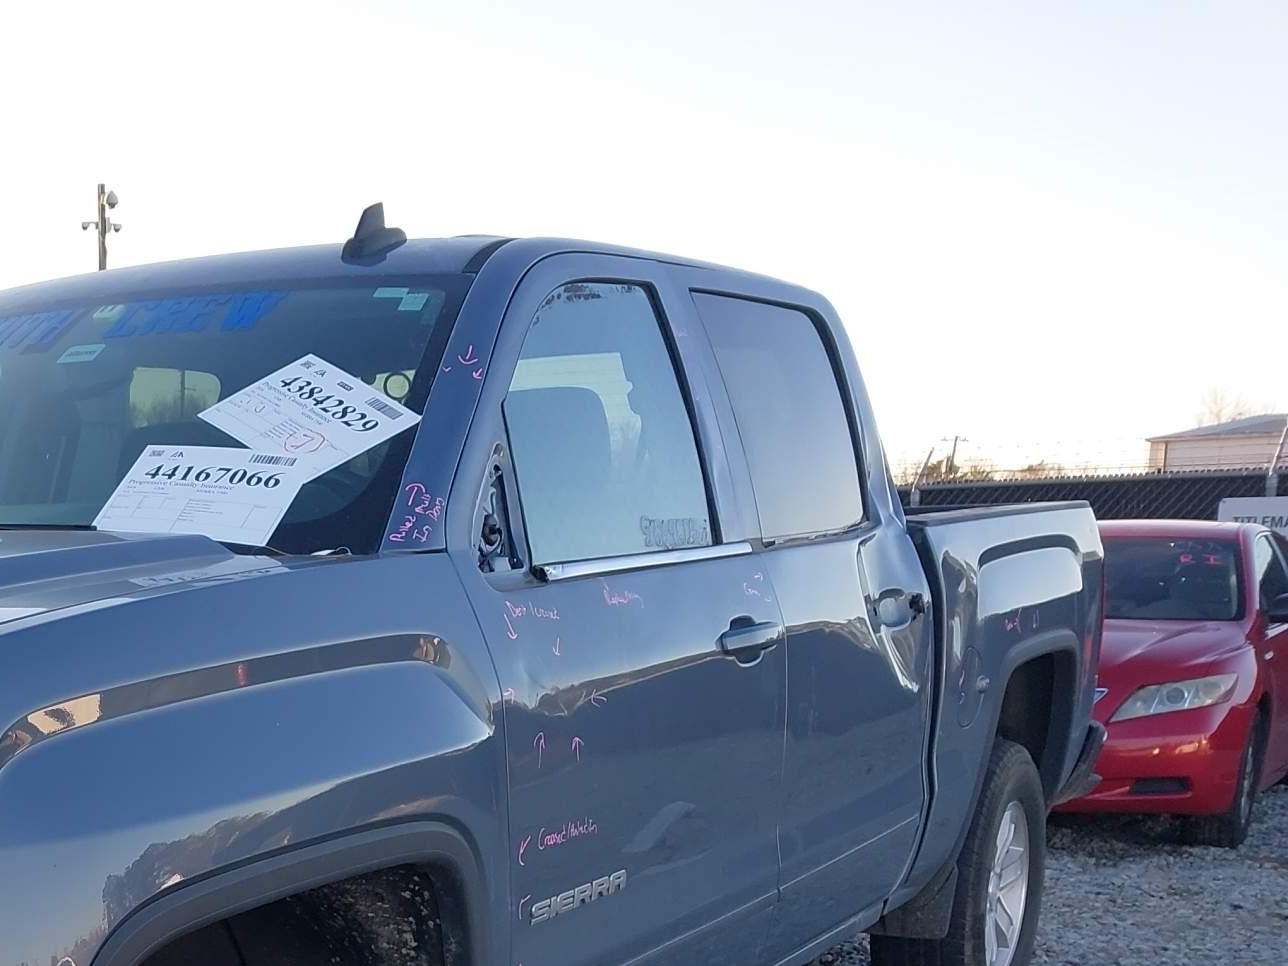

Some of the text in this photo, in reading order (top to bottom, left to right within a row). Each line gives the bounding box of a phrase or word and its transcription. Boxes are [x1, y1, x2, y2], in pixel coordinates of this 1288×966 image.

[102, 290, 290, 339] CREW
[279, 375, 380, 433] 43842829
[144, 463, 287, 490] 44167066
[530, 868, 628, 926] SIERRA
